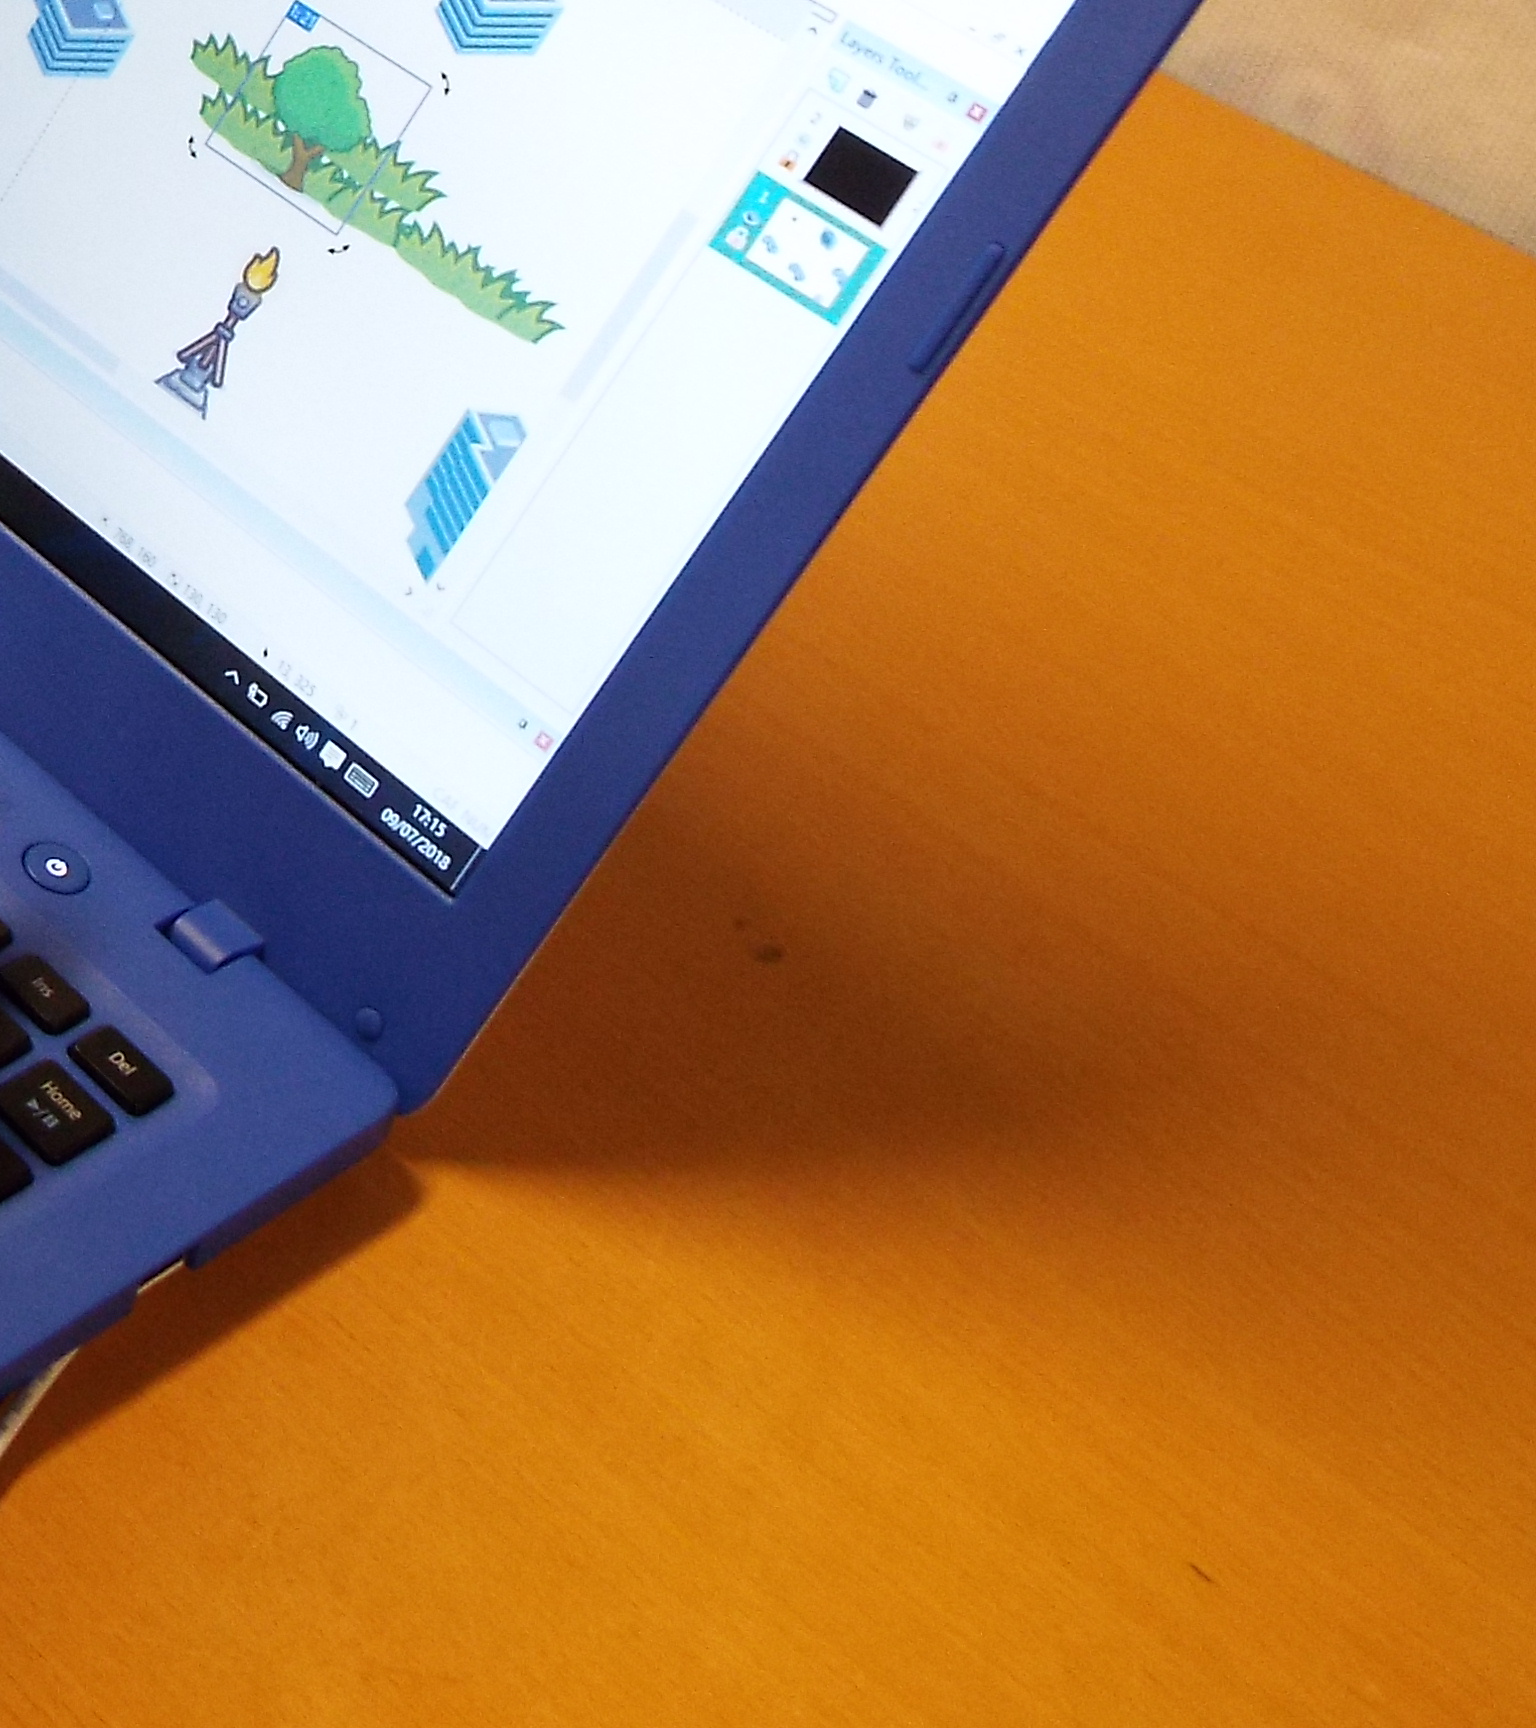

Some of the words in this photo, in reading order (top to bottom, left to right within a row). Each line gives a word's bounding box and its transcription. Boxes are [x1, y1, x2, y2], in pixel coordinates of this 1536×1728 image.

[837, 30, 887, 68] Layers
[412, 803, 448, 838] 17:15
[380, 807, 452, 871] 09/07/2018
[31, 976, 54, 999] Ins
[108, 1050, 138, 1077] Del
[40, 1080, 83, 1121] Home
